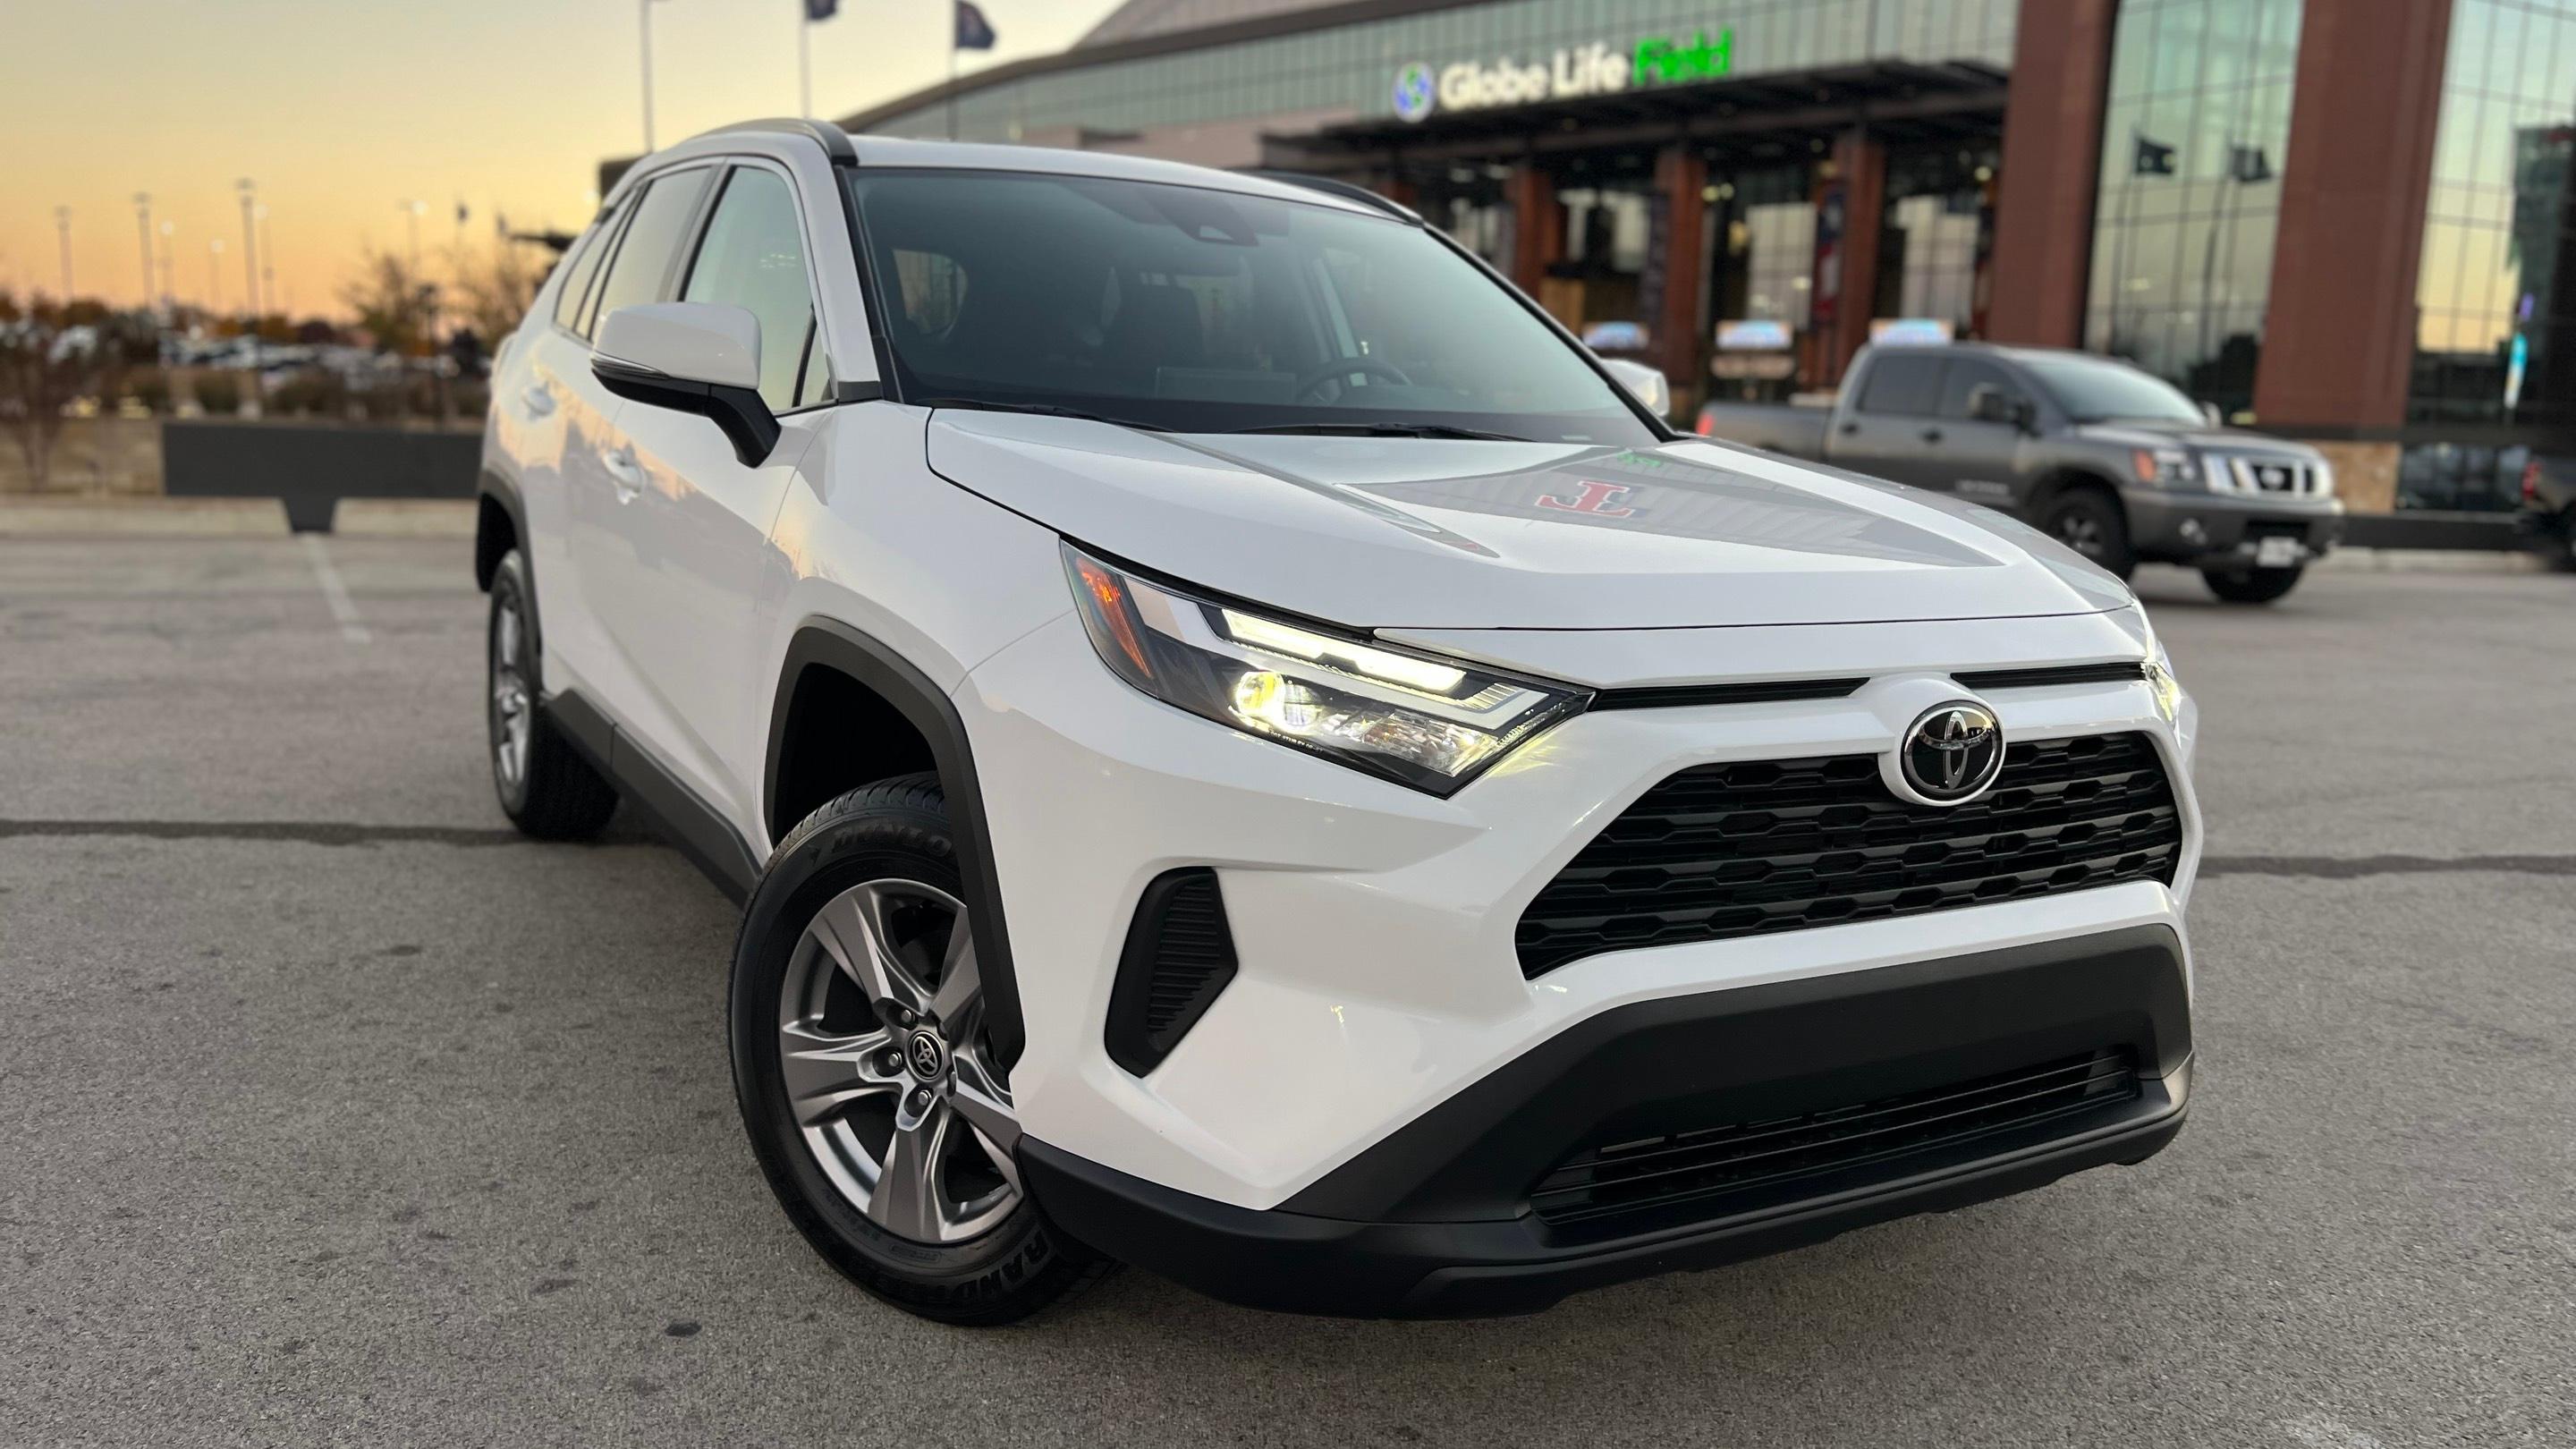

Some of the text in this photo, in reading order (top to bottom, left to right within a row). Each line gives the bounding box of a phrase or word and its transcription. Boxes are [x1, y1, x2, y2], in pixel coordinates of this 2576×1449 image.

[1440, 26, 1733, 109] Globe Life Field
